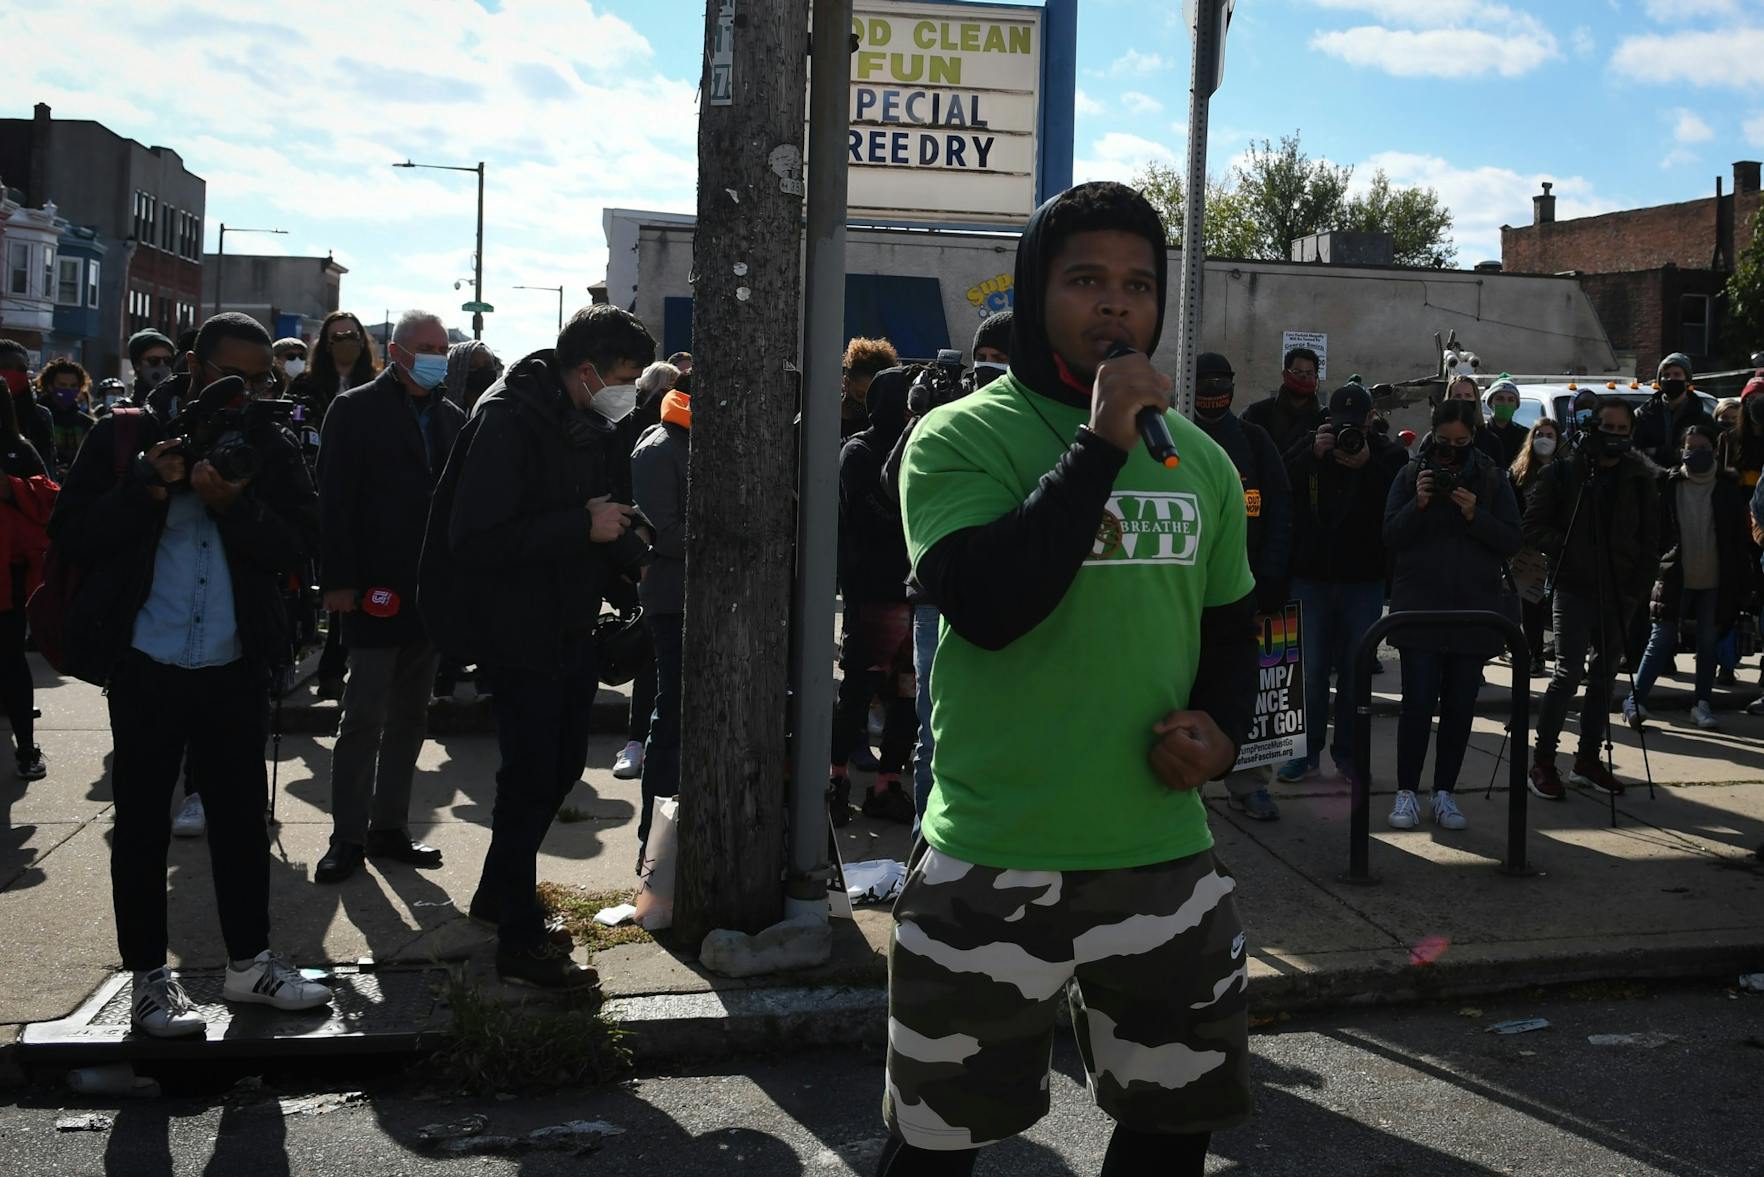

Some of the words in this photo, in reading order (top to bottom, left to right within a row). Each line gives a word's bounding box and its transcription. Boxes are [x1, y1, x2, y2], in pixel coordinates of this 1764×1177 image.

[851, 16, 892, 47] OD
[913, 20, 1032, 55] CLEAN
[857, 51, 962, 85] FUN
[856, 87, 989, 128] PECIAL
[848, 129, 910, 165] REE
[1120, 520, 1191, 534] BREATHE
[1256, 604, 1299, 668] O!
[1259, 664, 1295, 692] MP/
[1255, 688, 1290, 715] NCE
[1247, 715, 1269, 741] ST
[1273, 709, 1303, 736] GO!
[1237, 749, 1294, 765] efuseFascism.org
